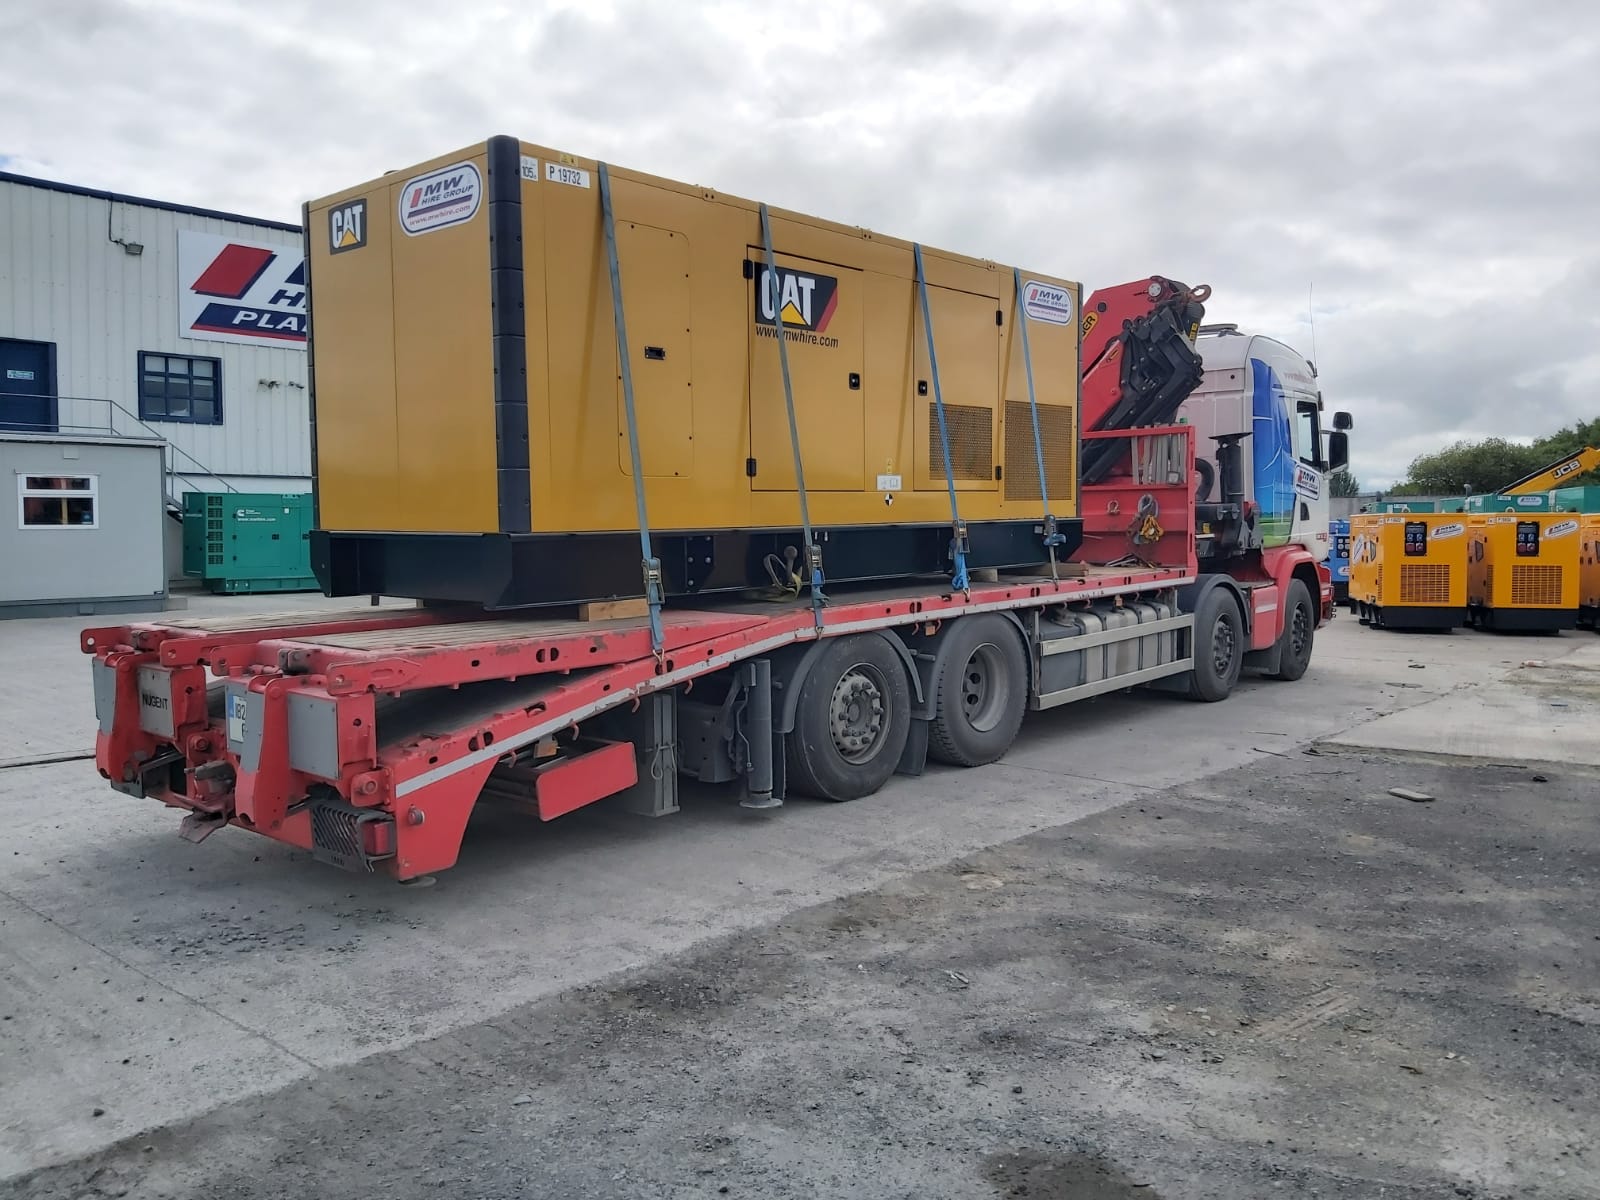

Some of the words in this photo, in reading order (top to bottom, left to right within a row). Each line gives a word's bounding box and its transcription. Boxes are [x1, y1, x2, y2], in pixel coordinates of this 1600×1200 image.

[424, 175, 464, 197] MW
[549, 165, 555, 179] P
[558, 167, 582, 186] 19732
[421, 194, 442, 206] HIRE
[443, 184, 474, 199] GROUP
[332, 204, 363, 249] CAT
[268, 288, 307, 309] H
[761, 269, 816, 327] CAT
[1039, 290, 1064, 302] MW
[232, 310, 307, 332] PLA
[756, 326, 839, 349] wwwmwhire.com
[1553, 460, 1581, 479] JCB
[142, 693, 168, 711] NUGENT
